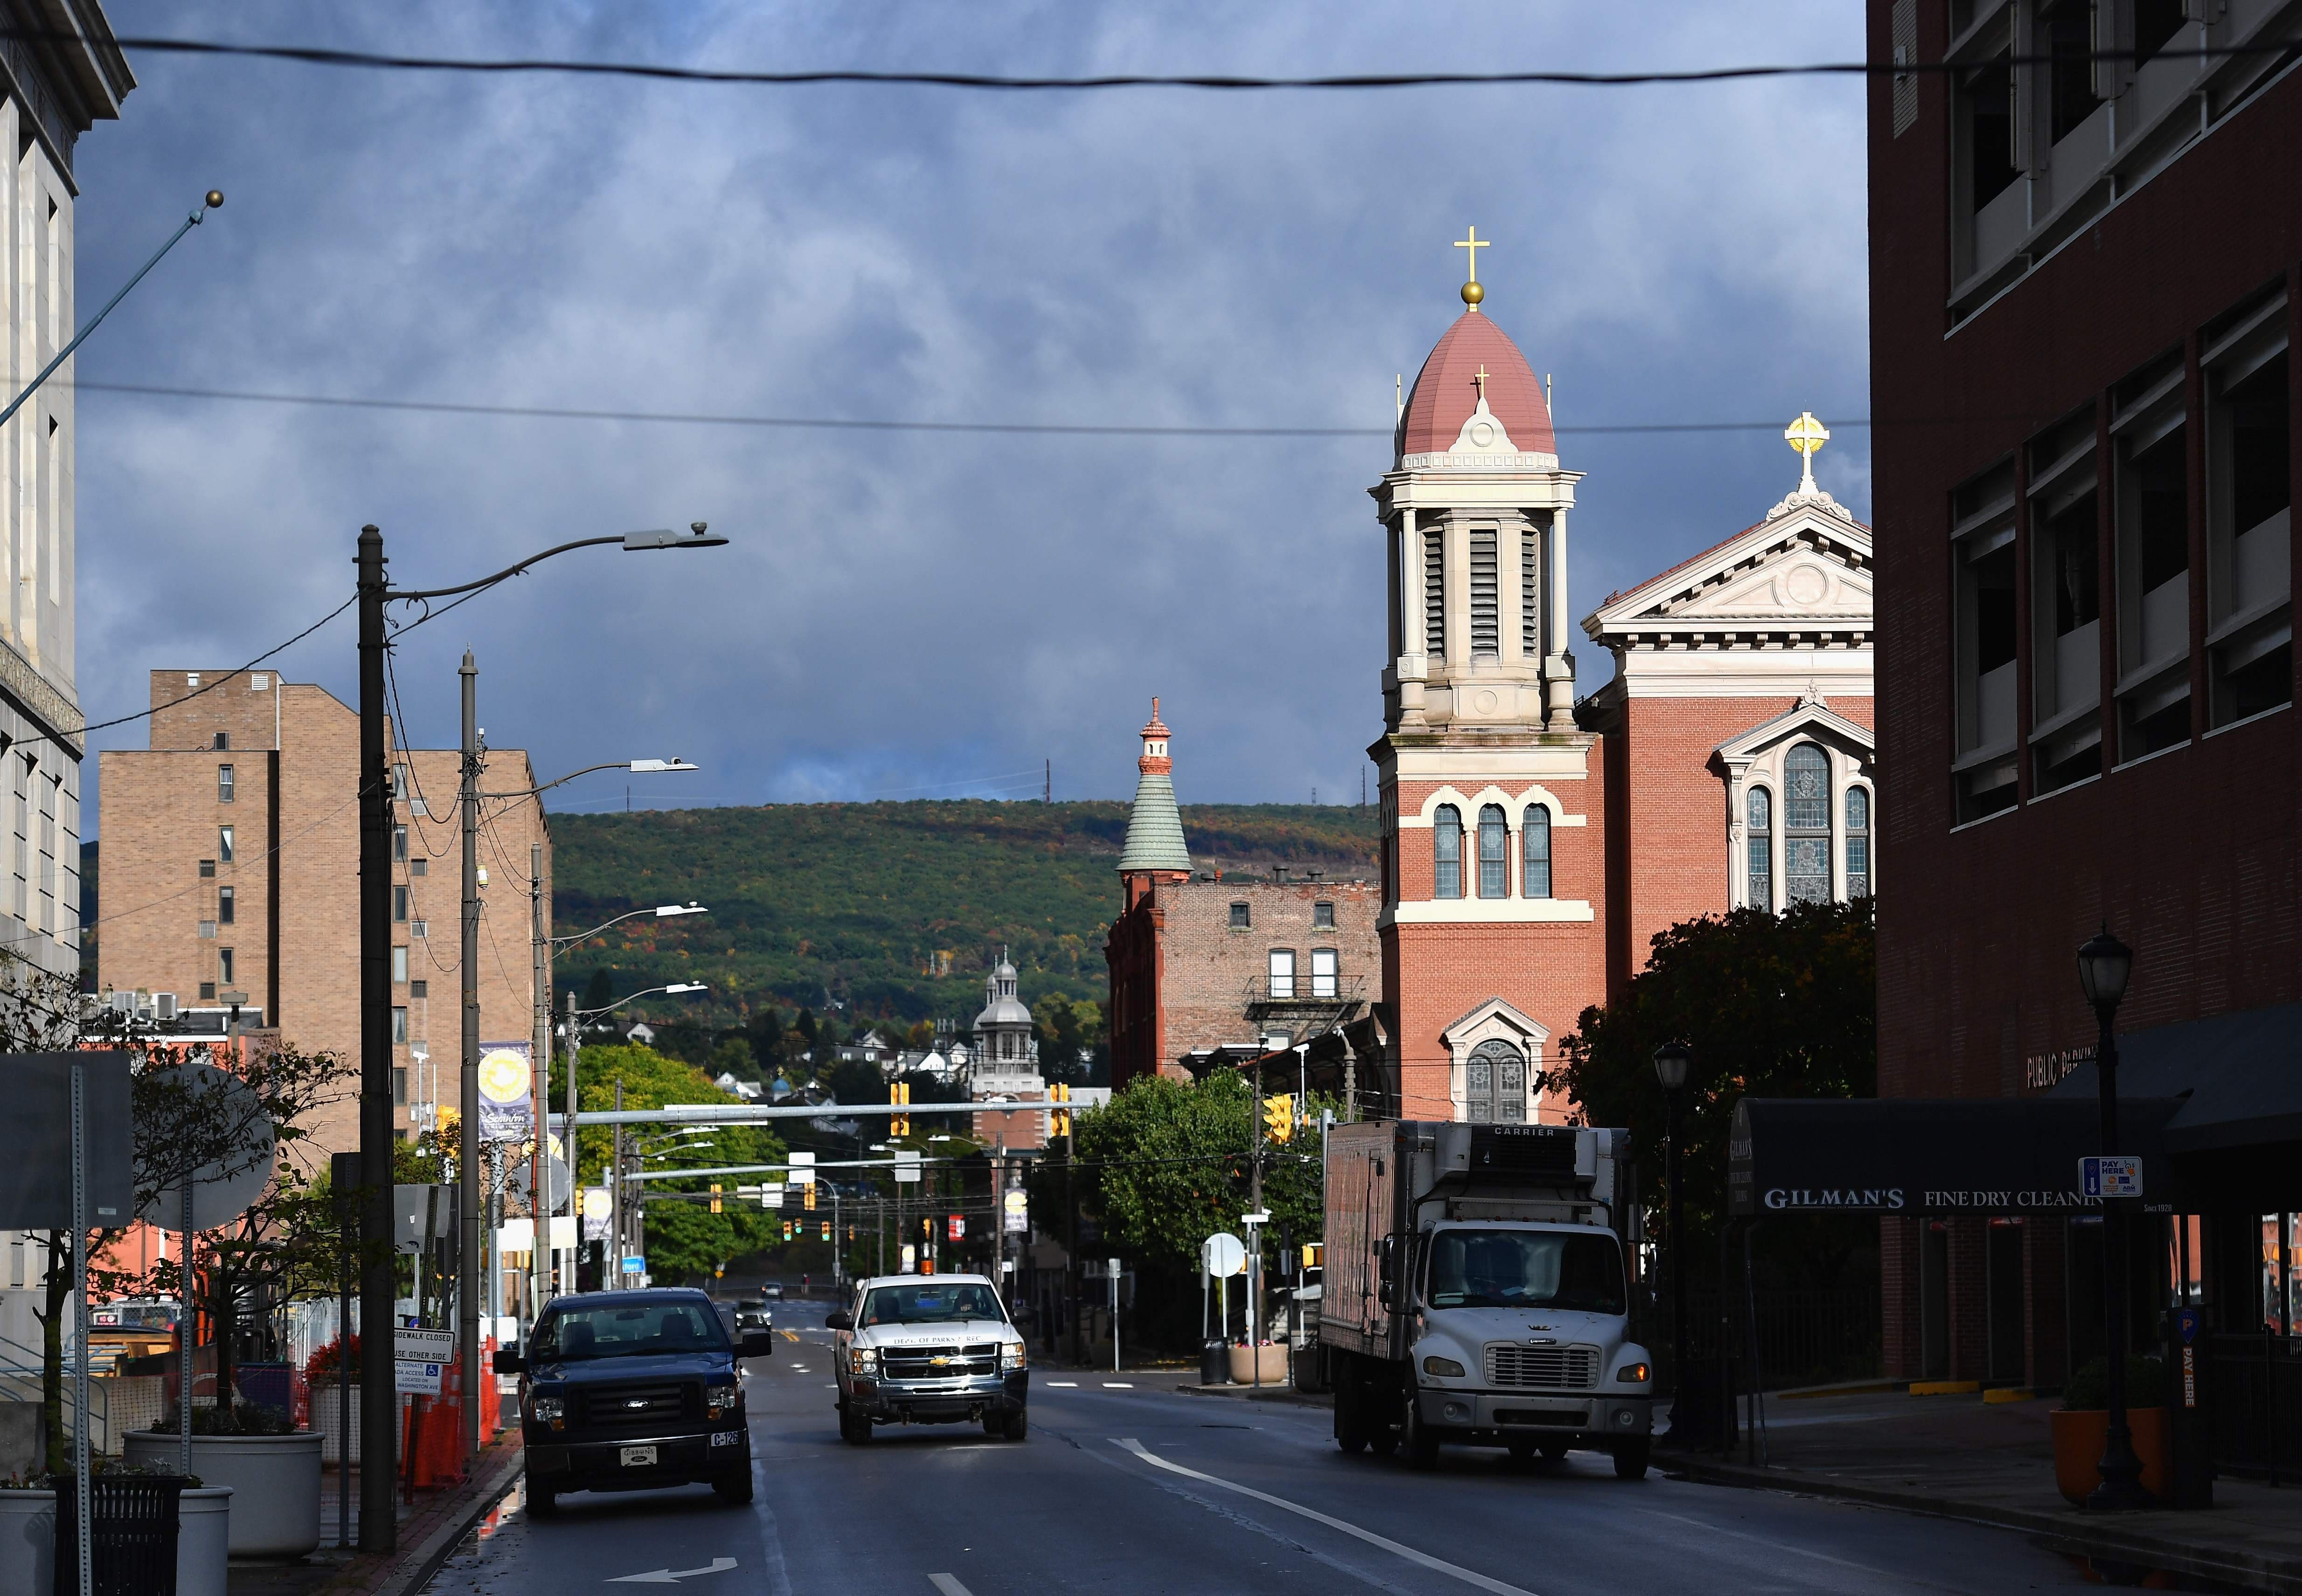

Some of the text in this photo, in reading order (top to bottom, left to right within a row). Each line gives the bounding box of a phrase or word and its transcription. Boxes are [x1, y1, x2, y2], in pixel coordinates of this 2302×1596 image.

[2027, 1053, 2057, 1089] PUBLIC
[484, 1113, 525, 1124] Scranton
[1495, 1128, 1554, 1136] CARRIER
[1765, 1188, 1903, 1209] GILMAN'S
[1924, 1191, 2104, 1206] FINE DRY CLEANIN
[2184, 1347, 2194, 1405] PAY HERE
[714, 1432, 738, 1445] C-126
